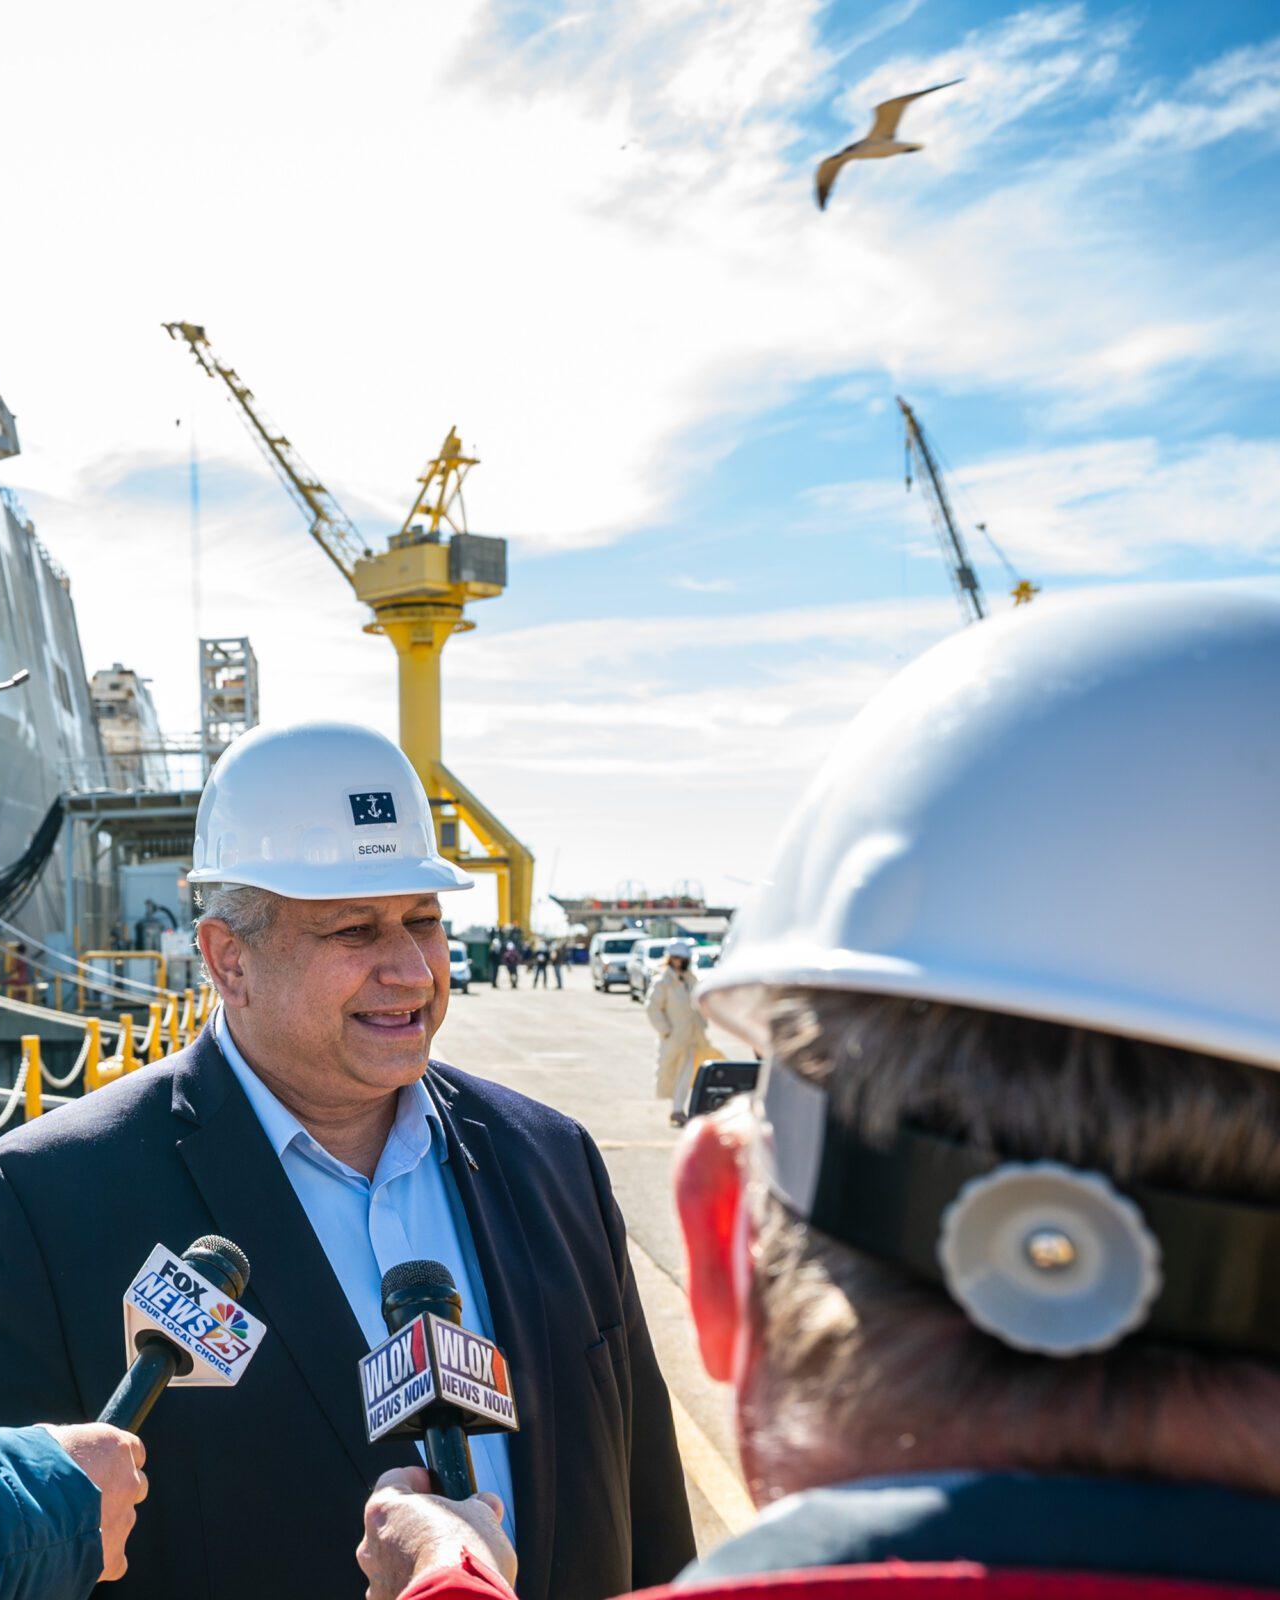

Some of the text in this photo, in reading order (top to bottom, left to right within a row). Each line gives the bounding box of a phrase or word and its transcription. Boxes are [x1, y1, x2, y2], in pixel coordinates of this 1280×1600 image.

[358, 844, 398, 855] SECNAV
[159, 1259, 208, 1307] FOX
[133, 1294, 233, 1377] YOUR LOCAL CHOICE
[134, 1273, 249, 1362] NEWS 25
[365, 1330, 415, 1405] WLOX
[437, 1325, 496, 1387] WLOX
[369, 1371, 433, 1431] NEWS NOW
[441, 1373, 514, 1419] NEWS NOW
